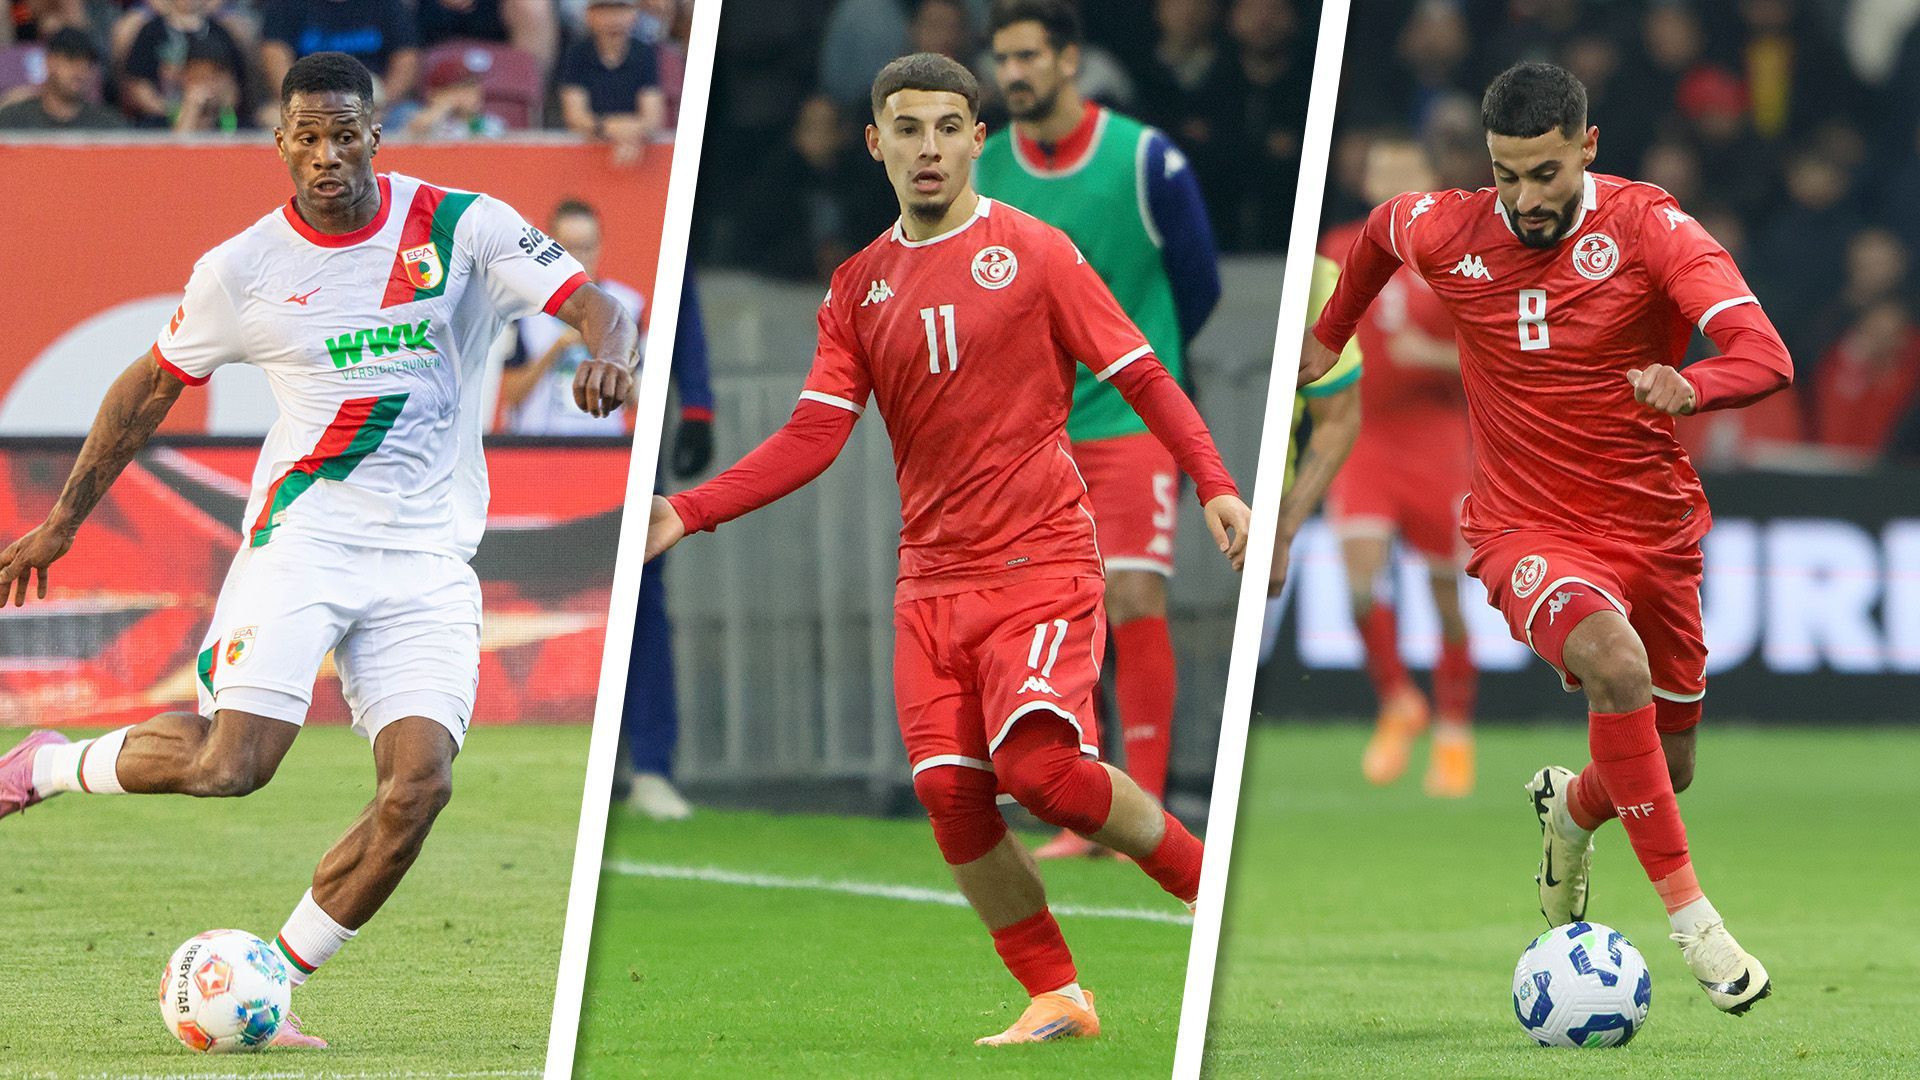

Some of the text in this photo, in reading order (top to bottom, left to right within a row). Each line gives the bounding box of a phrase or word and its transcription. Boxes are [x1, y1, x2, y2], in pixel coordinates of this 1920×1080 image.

[519, 226, 553, 255] sie
[324, 319, 437, 370] WWK
[919, 303, 959, 375] 11
[1517, 288, 1551, 352] 8
[1027, 618, 1069, 679] 11
[1616, 801, 1655, 820] FTF
[177, 944, 202, 1014] DERBYSTAR
